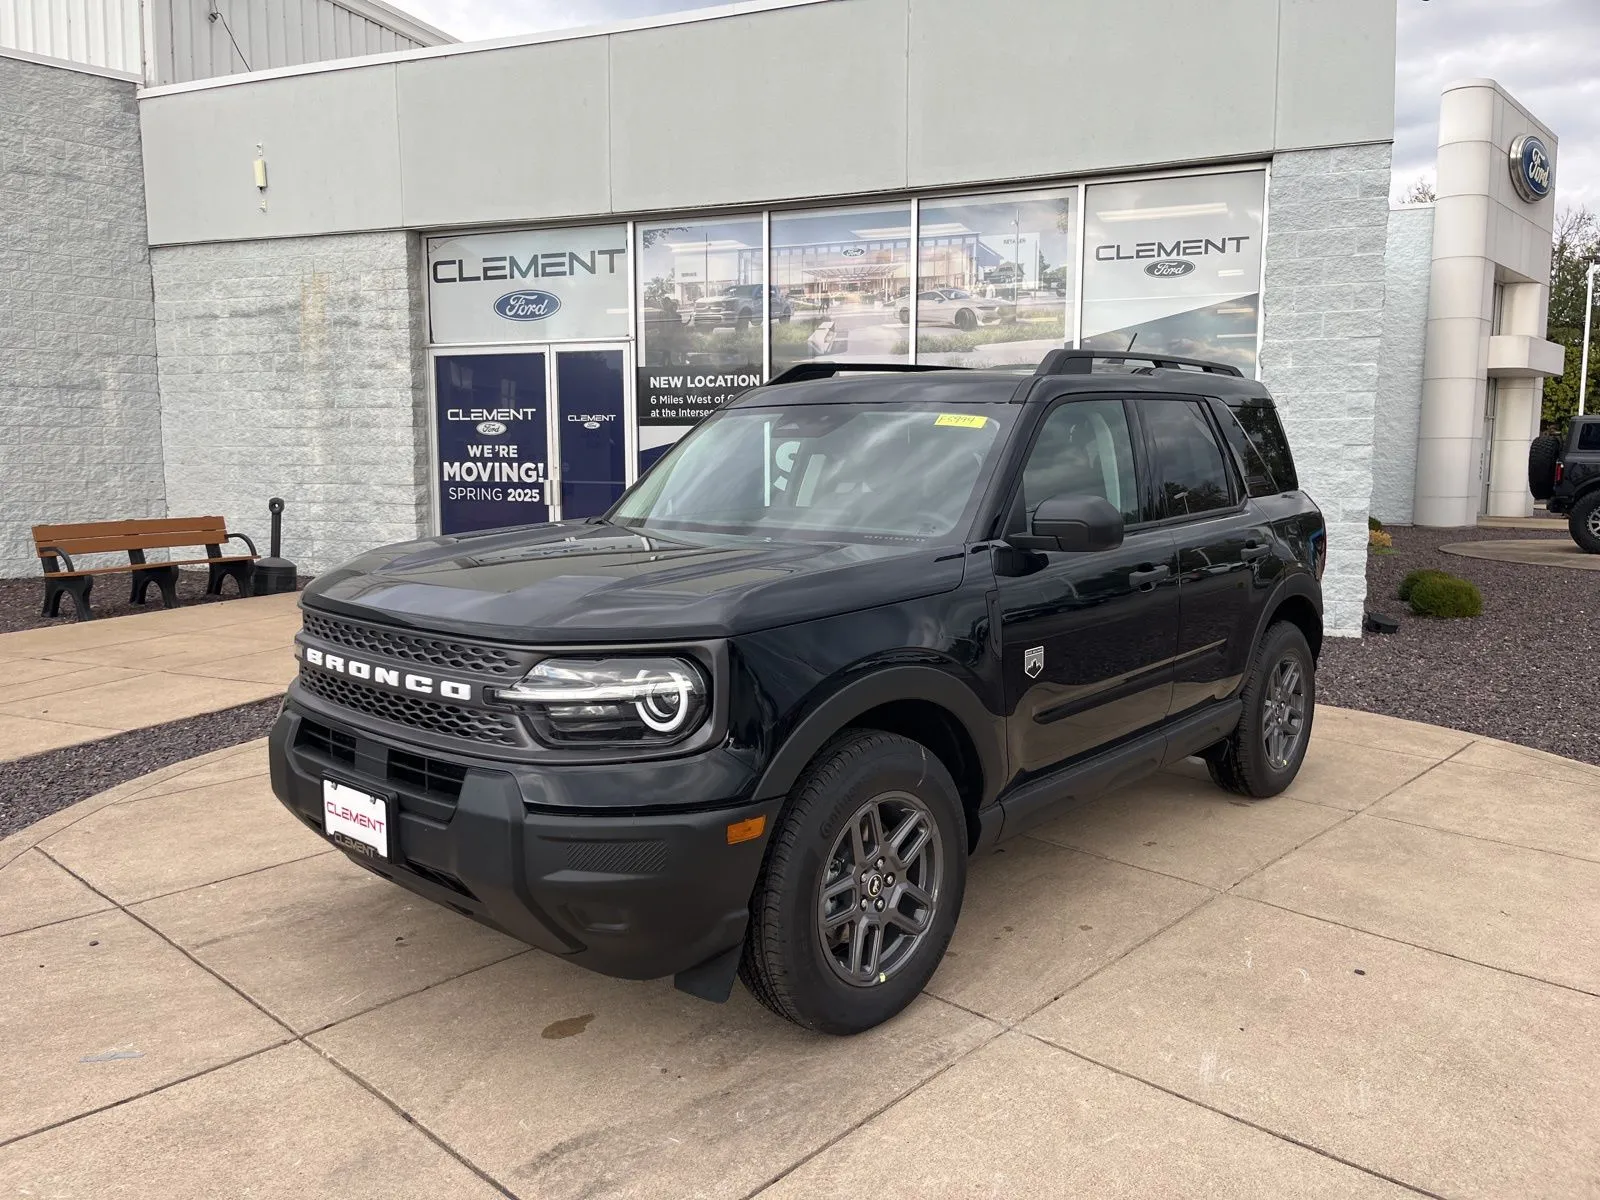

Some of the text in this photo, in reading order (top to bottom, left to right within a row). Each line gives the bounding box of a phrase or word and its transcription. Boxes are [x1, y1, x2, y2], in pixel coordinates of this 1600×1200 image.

[1528, 147, 1550, 188] Ford
[1095, 236, 1250, 261] CLEMENT
[432, 248, 626, 284] CLEMENT
[1154, 261, 1186, 276] Ford
[505, 293, 549, 317] Ford
[649, 374, 760, 389] NEW LOCATION
[650, 395, 657, 404] 6
[659, 395, 684, 404] Miles
[686, 395, 712, 404] West
[714, 394, 725, 404] of
[447, 408, 537, 421] CLEMENT
[567, 414, 617, 422] CLEMENT
[650, 408, 660, 418] at
[662, 408, 676, 418] the
[481, 424, 501, 433] Ford
[467, 445, 519, 458] WE'RE
[443, 461, 545, 483] MOVING!
[449, 487, 540, 502] SPRING 2025
[306, 647, 472, 701] BRONCO
[326, 801, 385, 834] CLEMENT
[333, 832, 376, 858] CLEMENT
